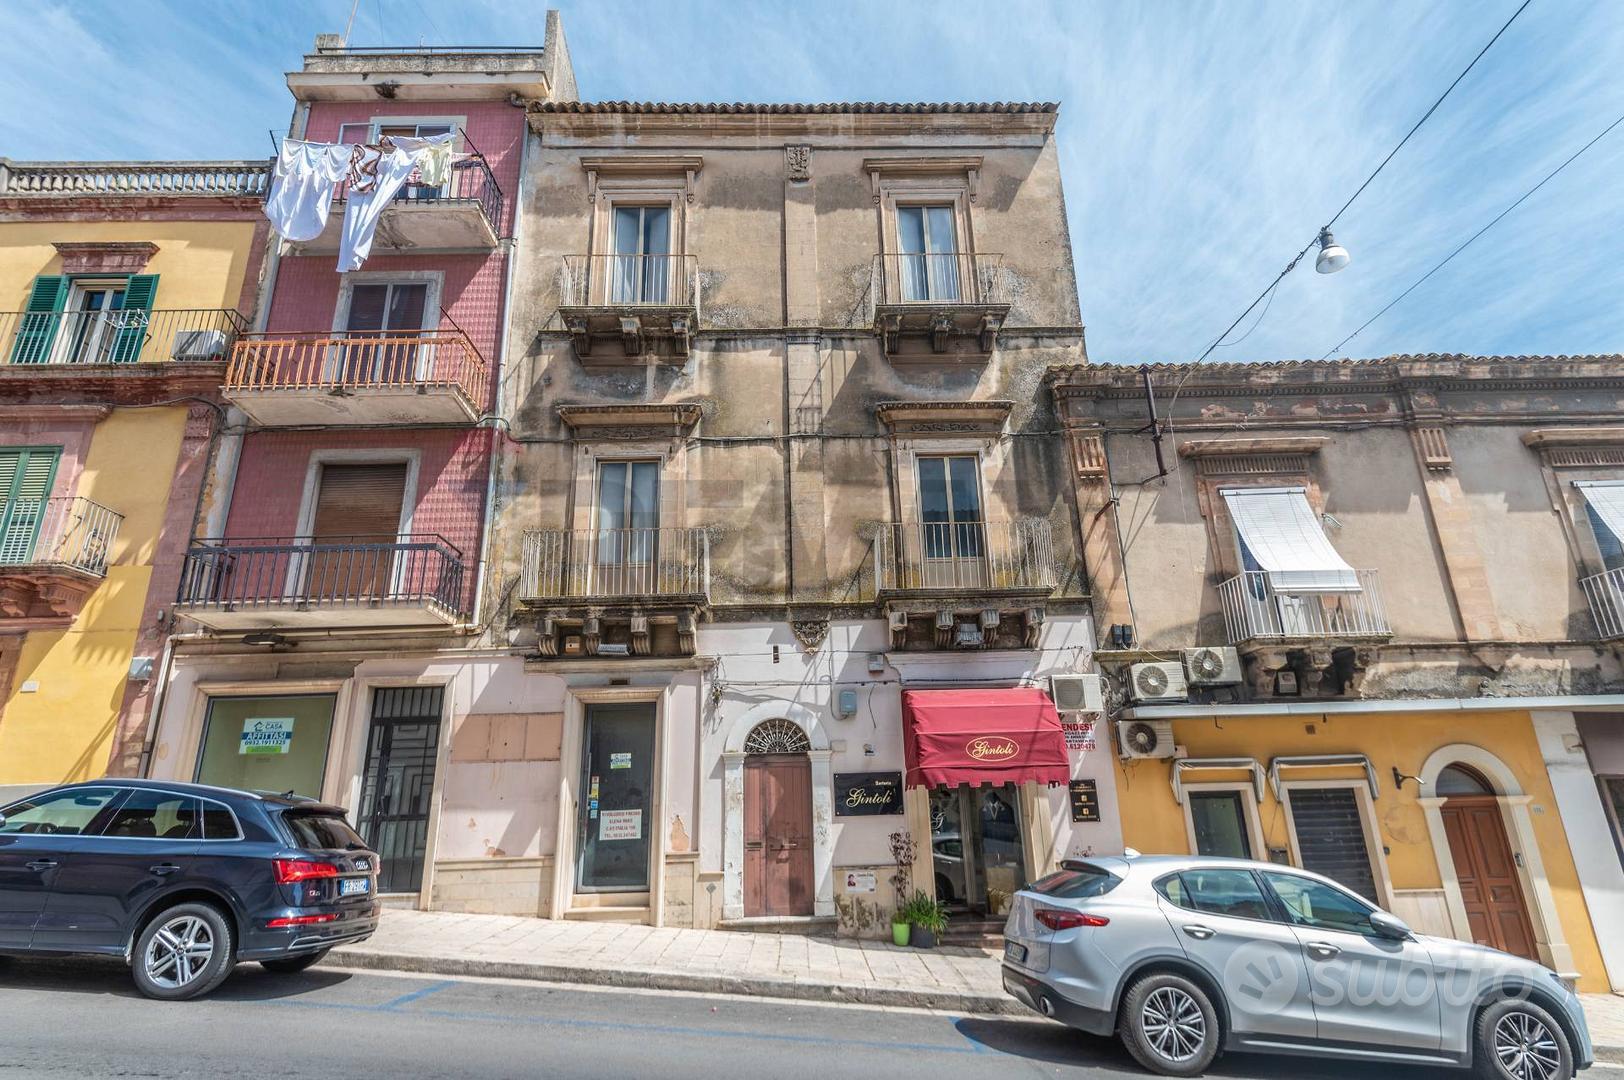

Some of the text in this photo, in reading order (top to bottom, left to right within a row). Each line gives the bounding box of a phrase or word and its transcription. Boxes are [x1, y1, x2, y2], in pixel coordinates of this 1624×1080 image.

[1061, 723, 1093, 731] ENDESI
[246, 731, 287, 740] AFFITTASI
[972, 741, 1013, 757] Gintoli
[846, 788, 892, 807] Gintoli
